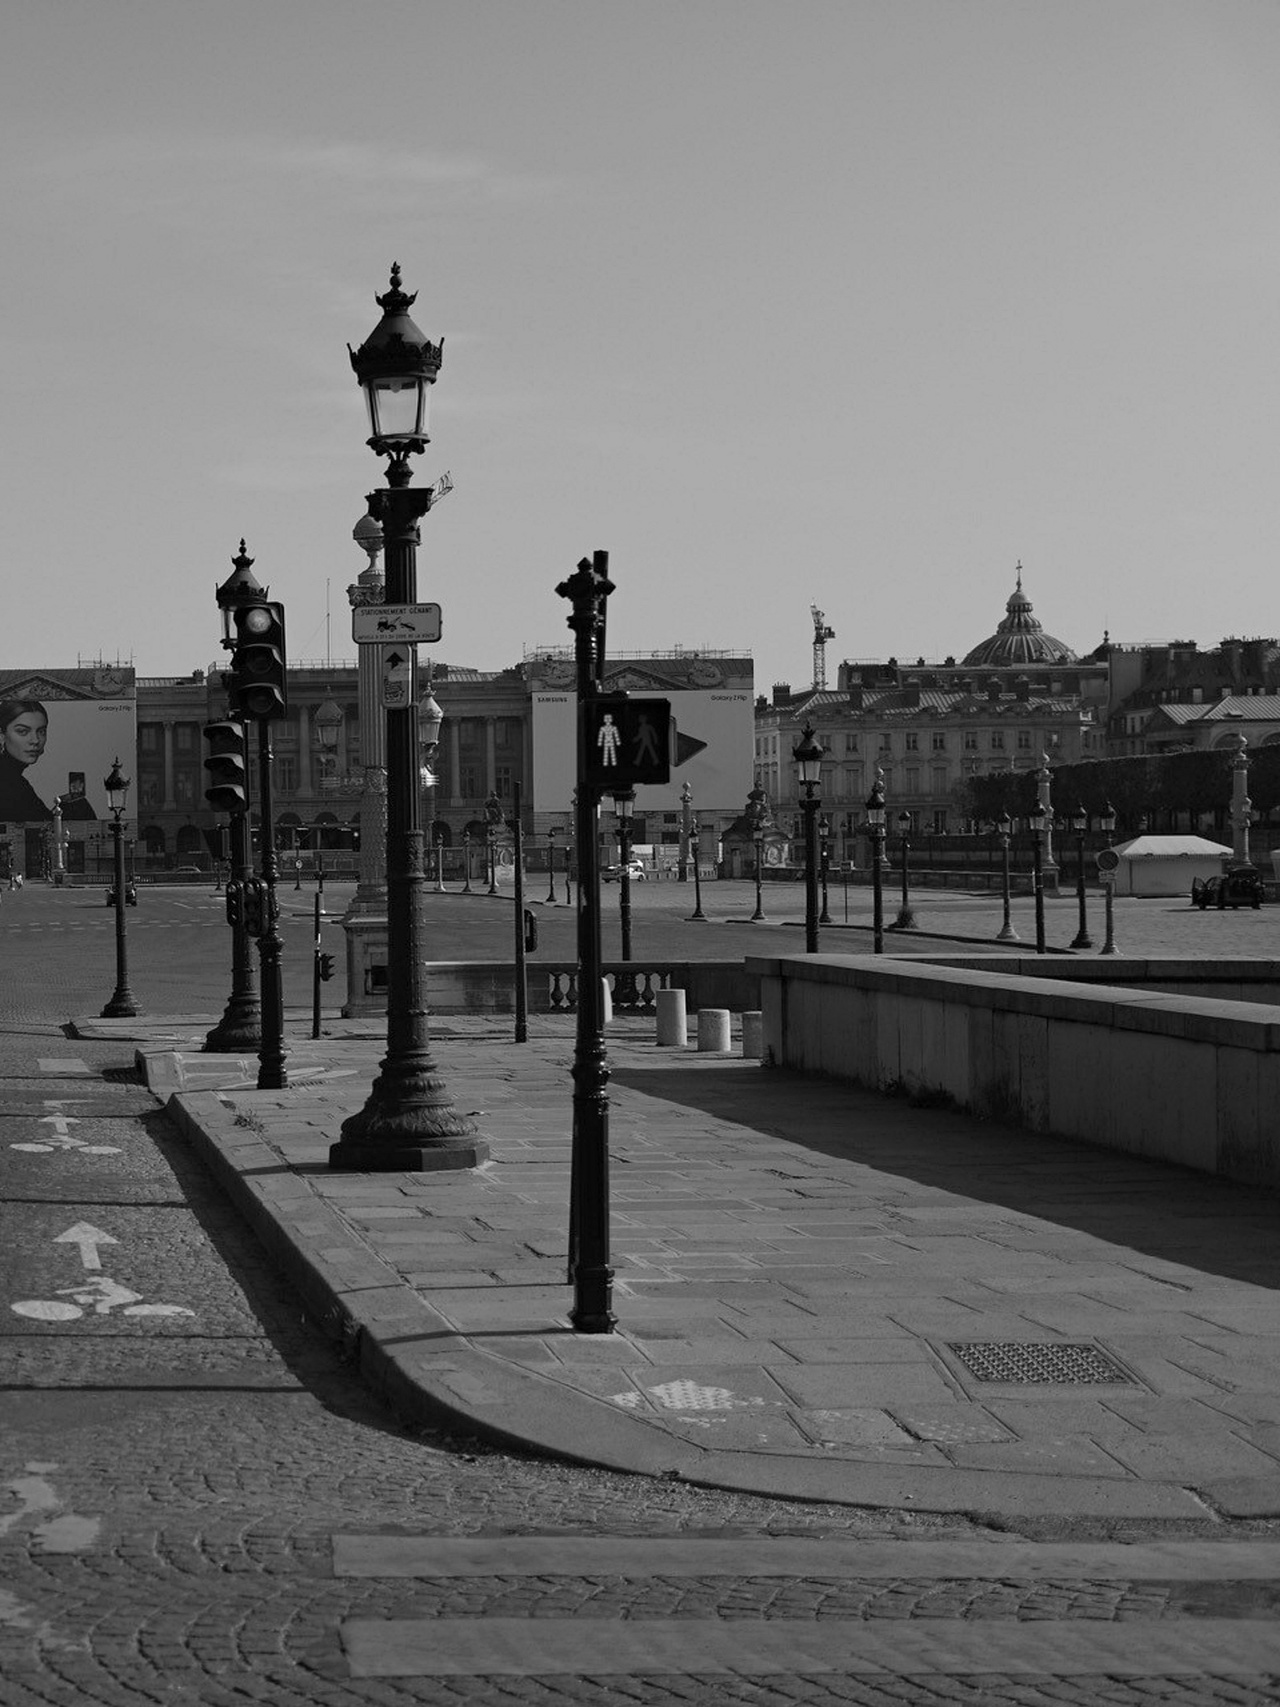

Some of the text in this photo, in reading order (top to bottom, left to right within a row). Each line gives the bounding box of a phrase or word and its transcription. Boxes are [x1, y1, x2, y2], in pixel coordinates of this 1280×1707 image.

[360, 608, 406, 616] STATIONNEMENT
[711, 694, 733, 703] Galaxy
[98, 705, 118, 713] Galaxy
